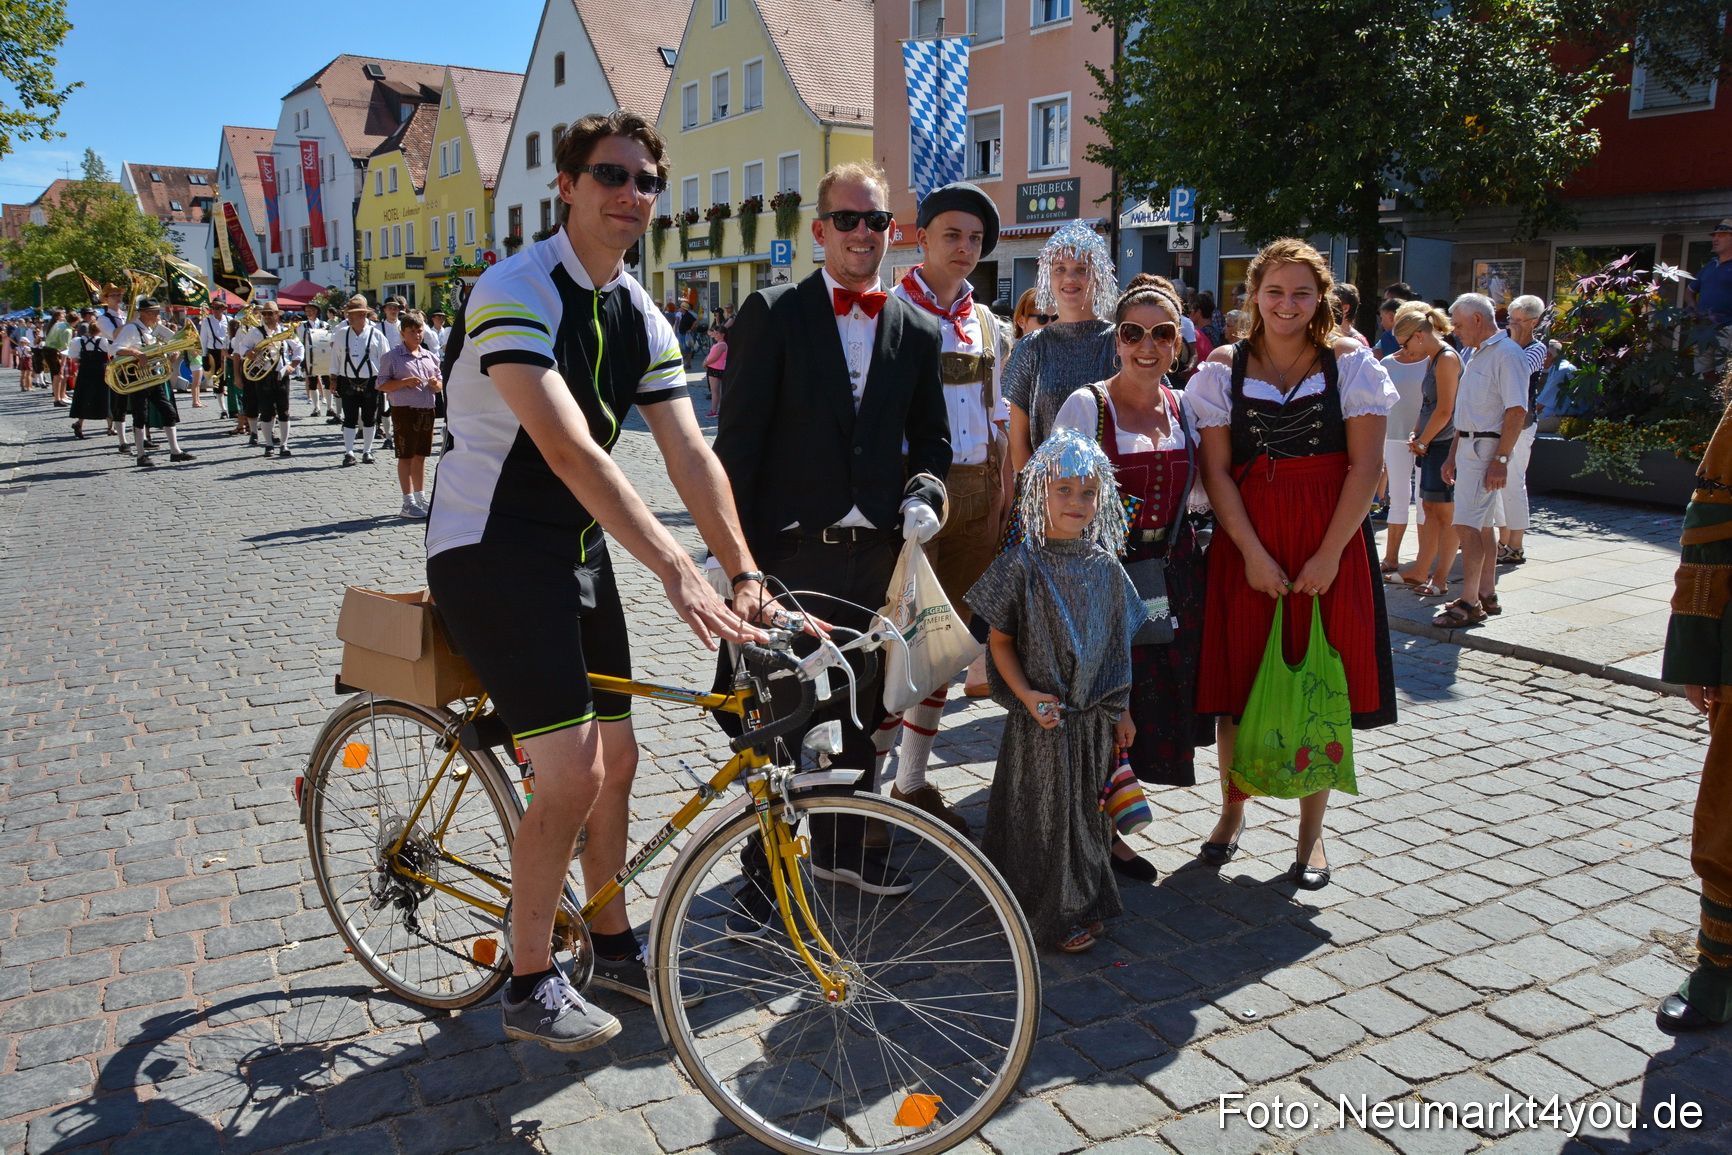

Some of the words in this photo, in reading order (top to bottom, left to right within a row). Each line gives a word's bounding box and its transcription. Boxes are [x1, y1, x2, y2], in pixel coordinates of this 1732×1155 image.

[303, 144, 314, 170] K&L
[1175, 188, 1190, 218] P
[383, 208, 399, 222] HOTEL
[1045, 210, 1068, 218] GEMÜSE
[688, 240, 701, 248] WOLLE
[775, 242, 787, 263] P
[1126, 248, 1134, 258] 16
[383, 271, 406, 281] Restaurant
[677, 271, 692, 280] WOLLE
[695, 269, 708, 279] MEHR
[619, 826, 670, 879] SLALOM
